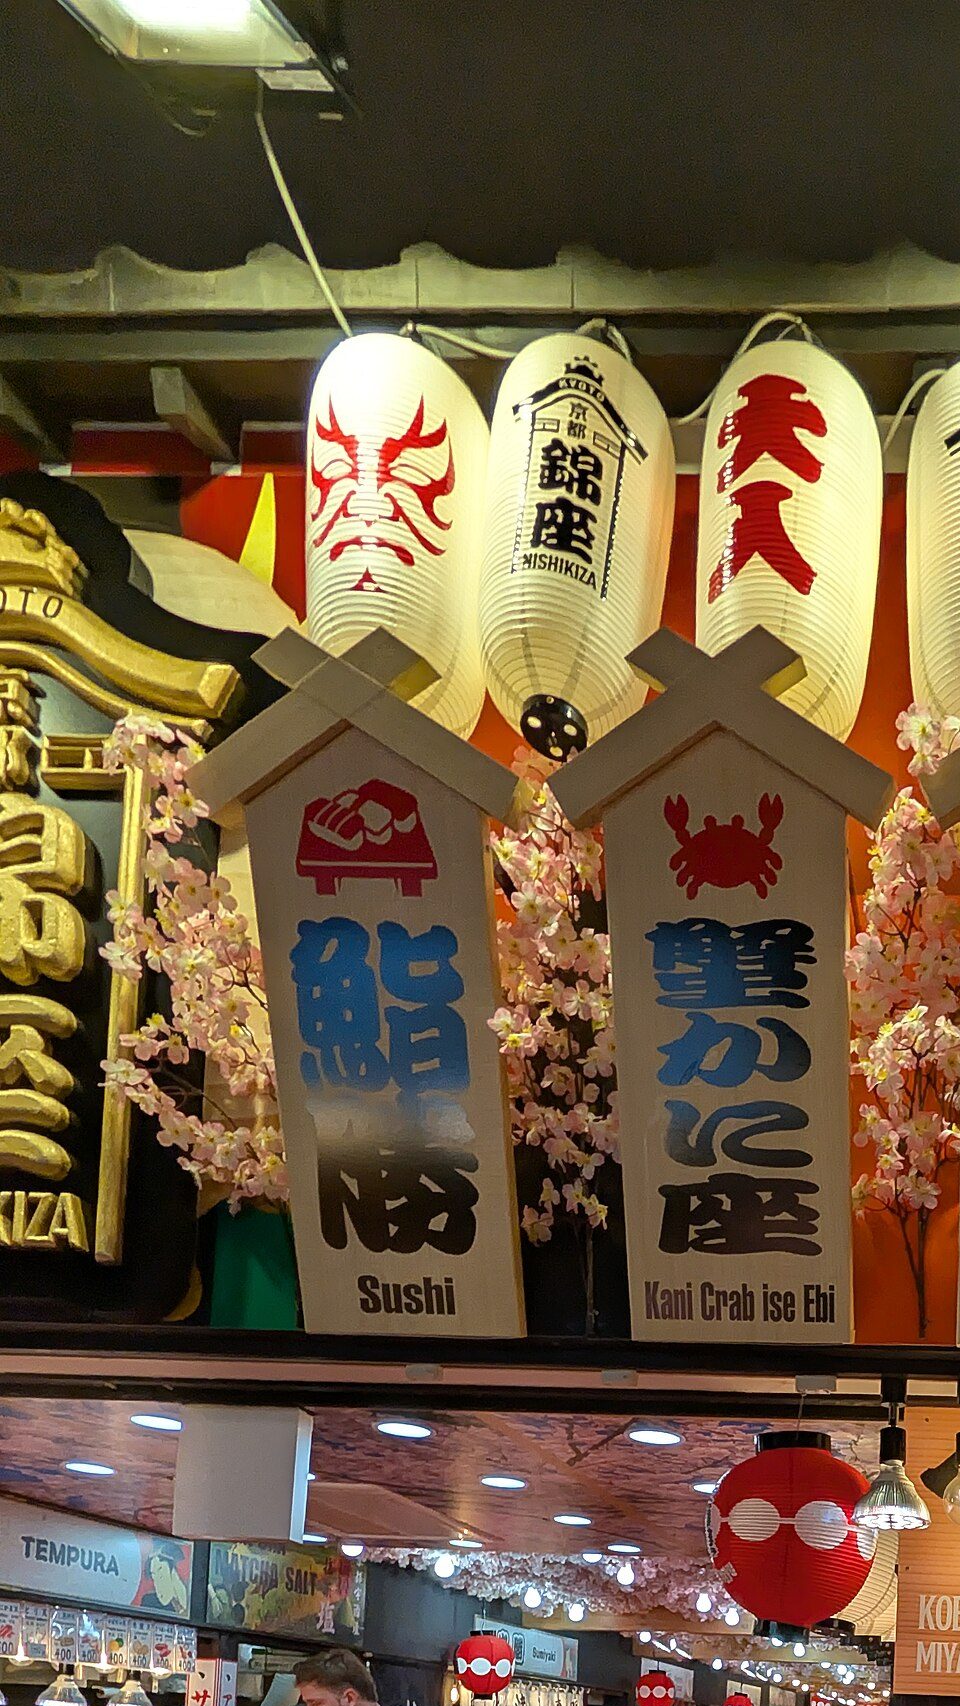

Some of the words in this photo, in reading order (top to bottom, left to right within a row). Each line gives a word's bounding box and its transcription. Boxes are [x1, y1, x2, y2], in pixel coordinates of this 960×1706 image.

[558, 377, 606, 402] KYOTO
[567, 402, 589, 440] 京都
[530, 437, 604, 565] 錦座
[522, 552, 598, 592] NISHIKIZA
[356, 1274, 457, 1316] Sushi
[644, 1280, 695, 1322] Kani
[700, 1280, 755, 1323] Crab
[761, 1282, 796, 1323] ise
[802, 1282, 836, 1324] Ebi
[21, 1535, 121, 1578] TEMPURA
[284, 1566, 319, 1597] SALT
